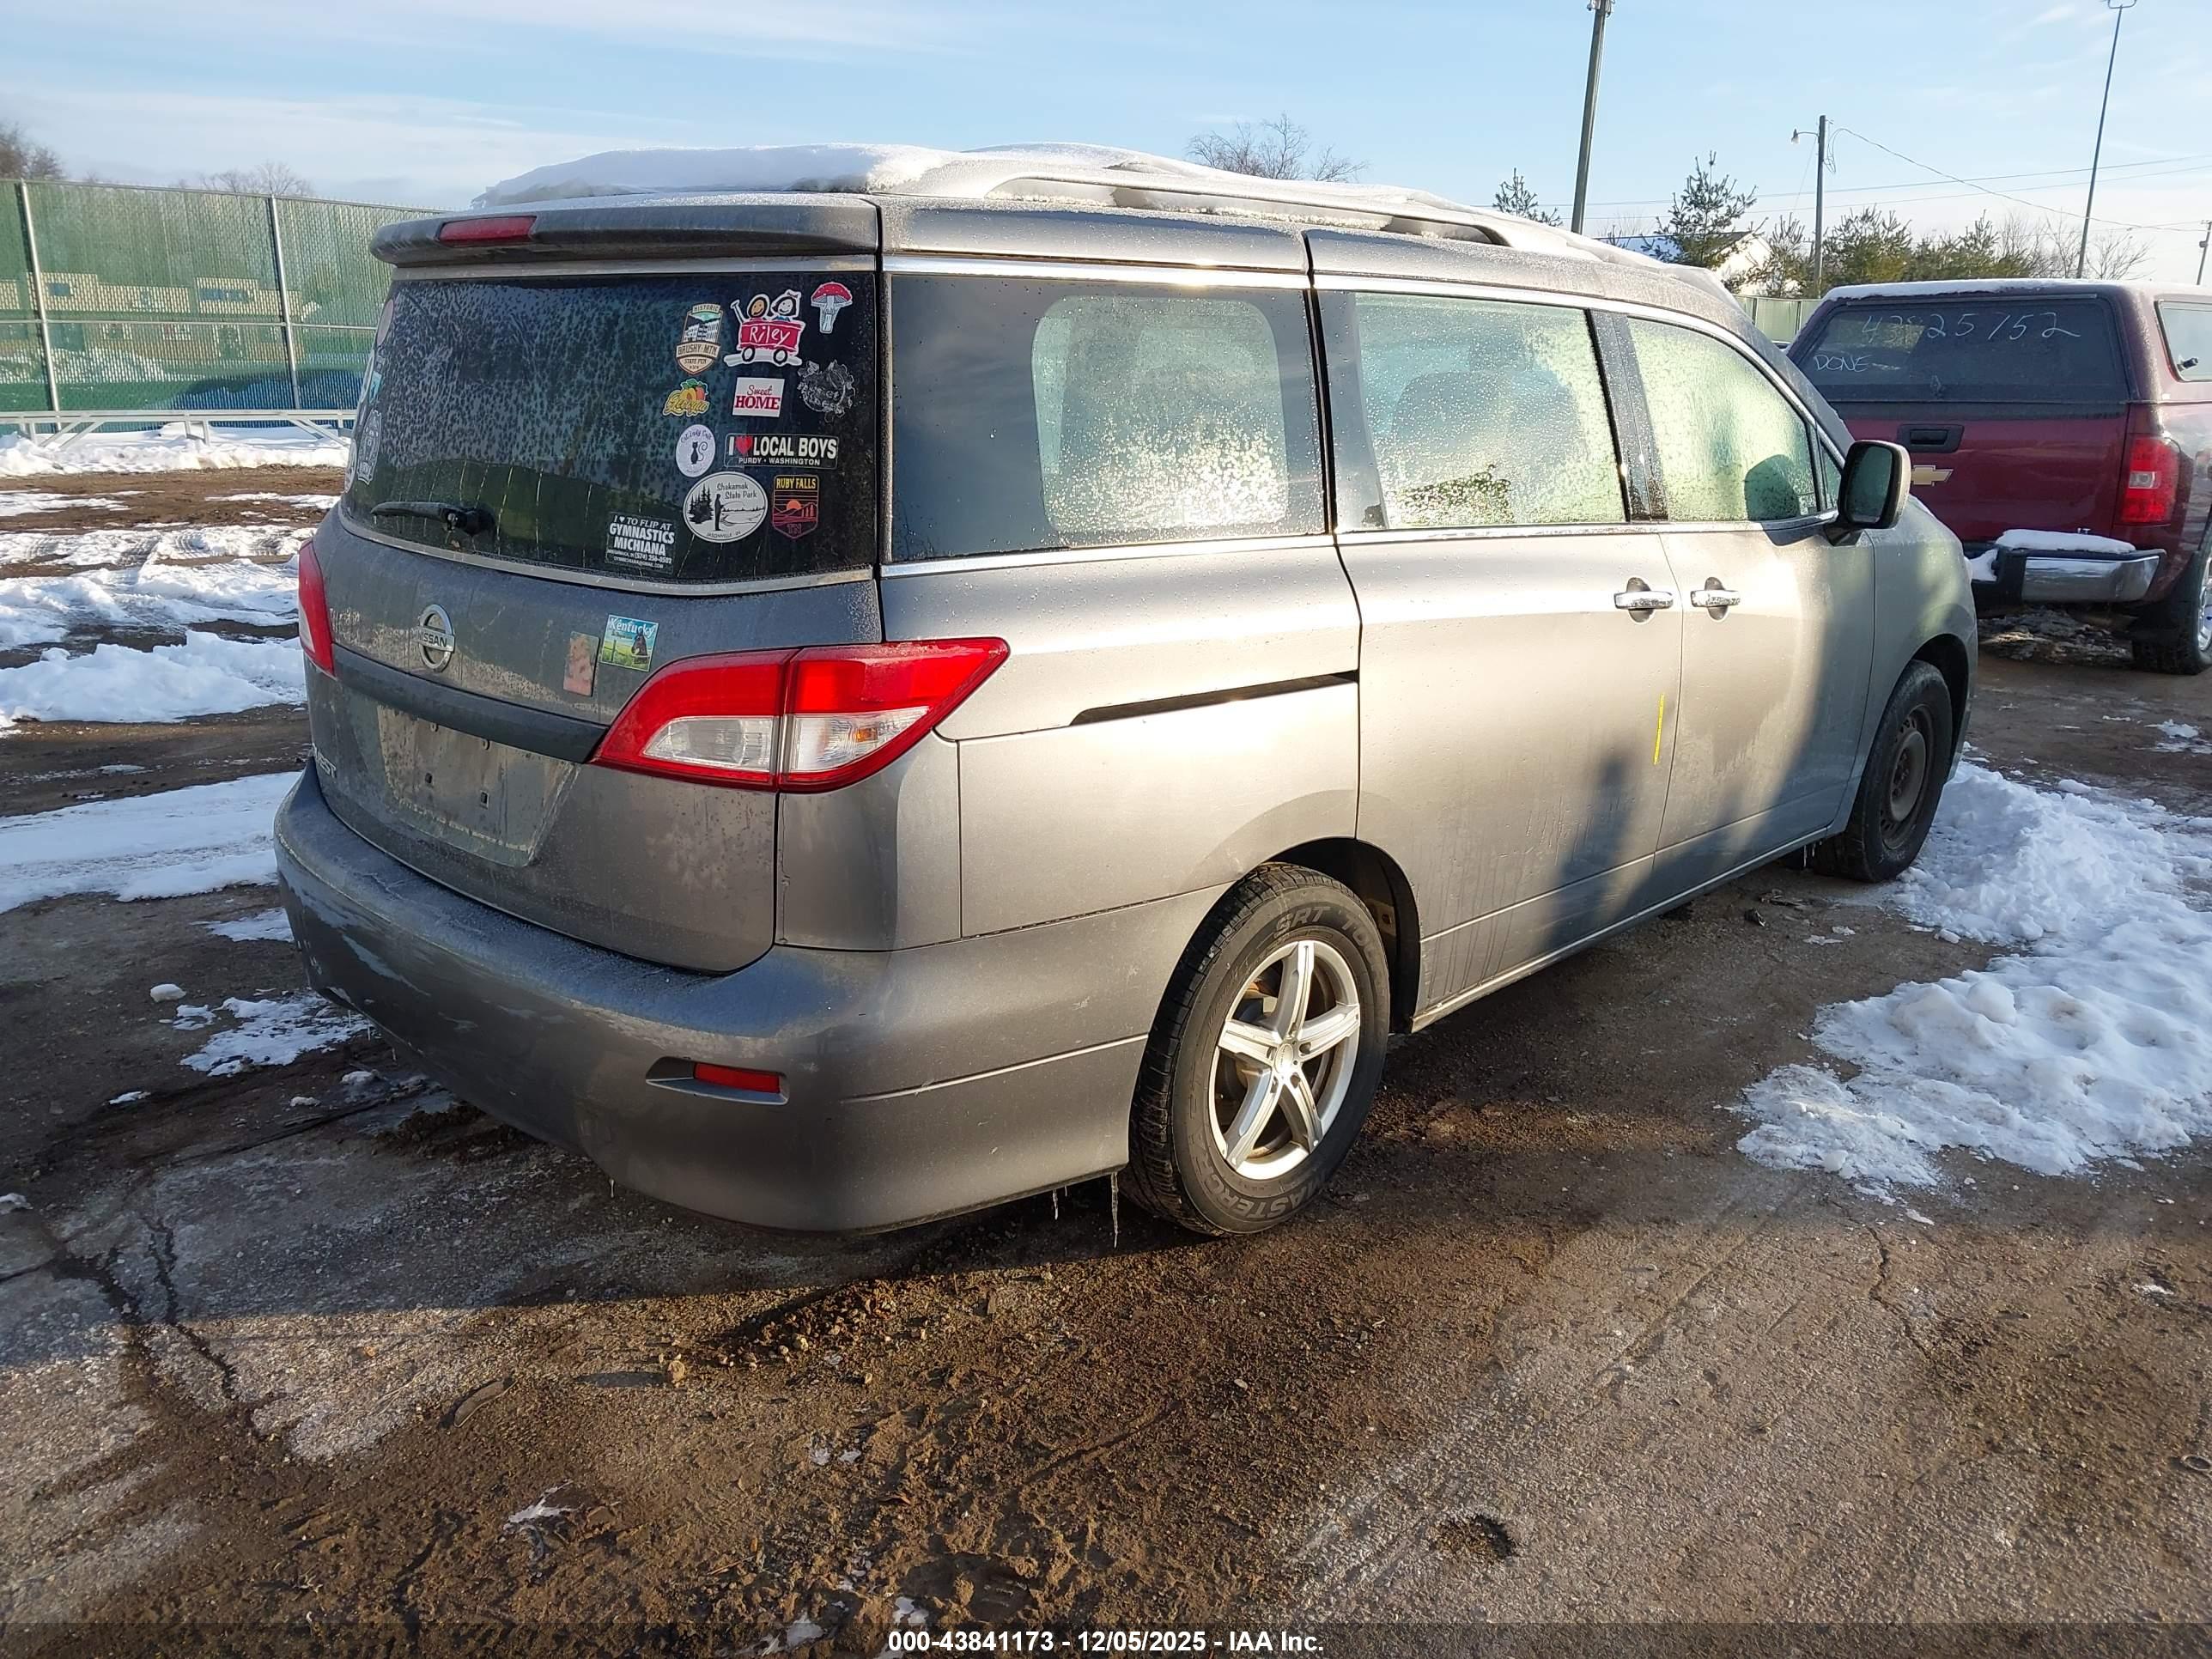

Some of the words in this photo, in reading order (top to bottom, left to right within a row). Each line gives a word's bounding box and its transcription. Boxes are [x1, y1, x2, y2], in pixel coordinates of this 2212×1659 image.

[750, 325, 790, 347] Riley
[678, 344, 702, 356] BRUSHY
[1814, 354, 1872, 372] DONE
[747, 384, 773, 395] Sweet
[734, 396, 781, 410] HOME
[728, 436, 735, 456] I
[753, 436, 794, 456] LOCAL
[798, 437, 837, 459] BOYS
[776, 477, 794, 489] RUBY
[795, 477, 816, 489] FALLS
[627, 517, 638, 526] TO
[640, 519, 659, 528] FLIP
[787, 523, 802, 534] TN
[610, 522, 675, 544] GYMNASTICS
[614, 536, 665, 556] MICHIANA
[610, 617, 655, 638] Kentucky
[418, 630, 447, 647] NISSAN
[1273, 906, 1330, 939] SRT
